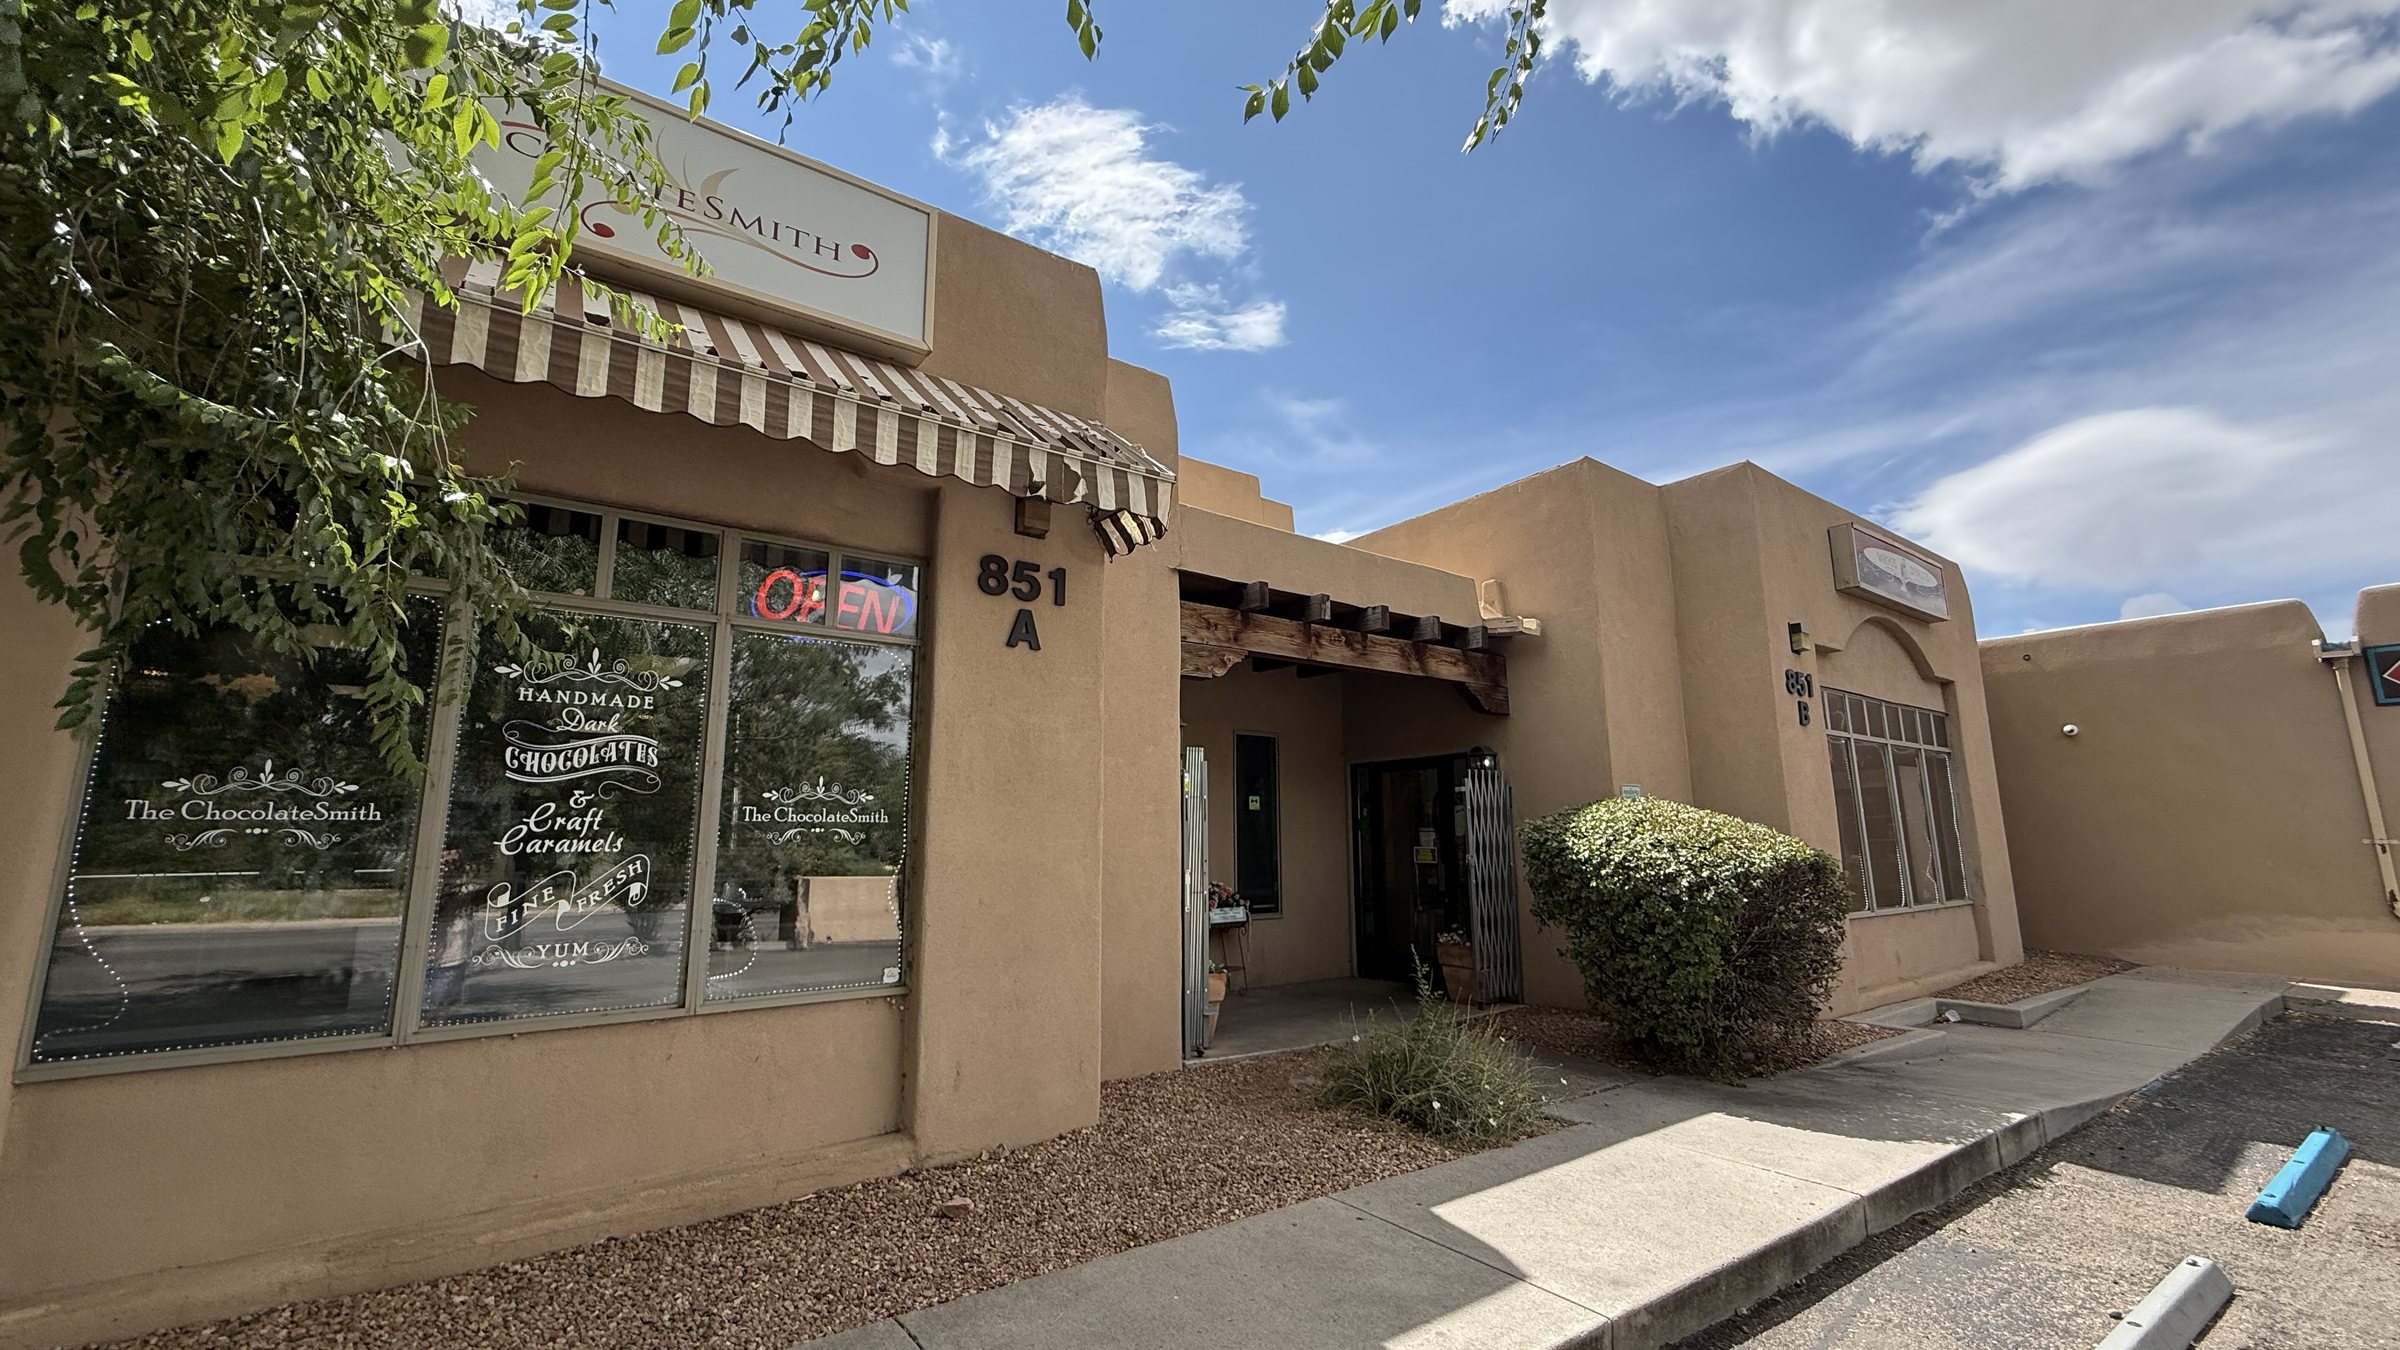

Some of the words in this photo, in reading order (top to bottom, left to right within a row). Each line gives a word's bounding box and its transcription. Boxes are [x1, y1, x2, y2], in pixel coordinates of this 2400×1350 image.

[978, 555, 1067, 606] 851
[756, 570, 899, 634] OPEN
[1006, 608, 1041, 651] A
[1785, 669, 1814, 697] 851
[518, 687, 655, 709] HANDMADE
[556, 708, 619, 733] Dark
[1797, 701, 1811, 726] B
[505, 739, 659, 775] CHOCOLATES
[125, 799, 175, 821] The
[181, 800, 382, 821] ChocolateSmith
[569, 790, 594, 809] &
[523, 802, 603, 838] Craft
[743, 806, 771, 822] The
[774, 806, 889, 824] ChocolateSmith
[493, 825, 624, 855] Caramels
[495, 886, 555, 933] FINE
[576, 859, 643, 914] FRESH
[536, 941, 589, 959] YUM
